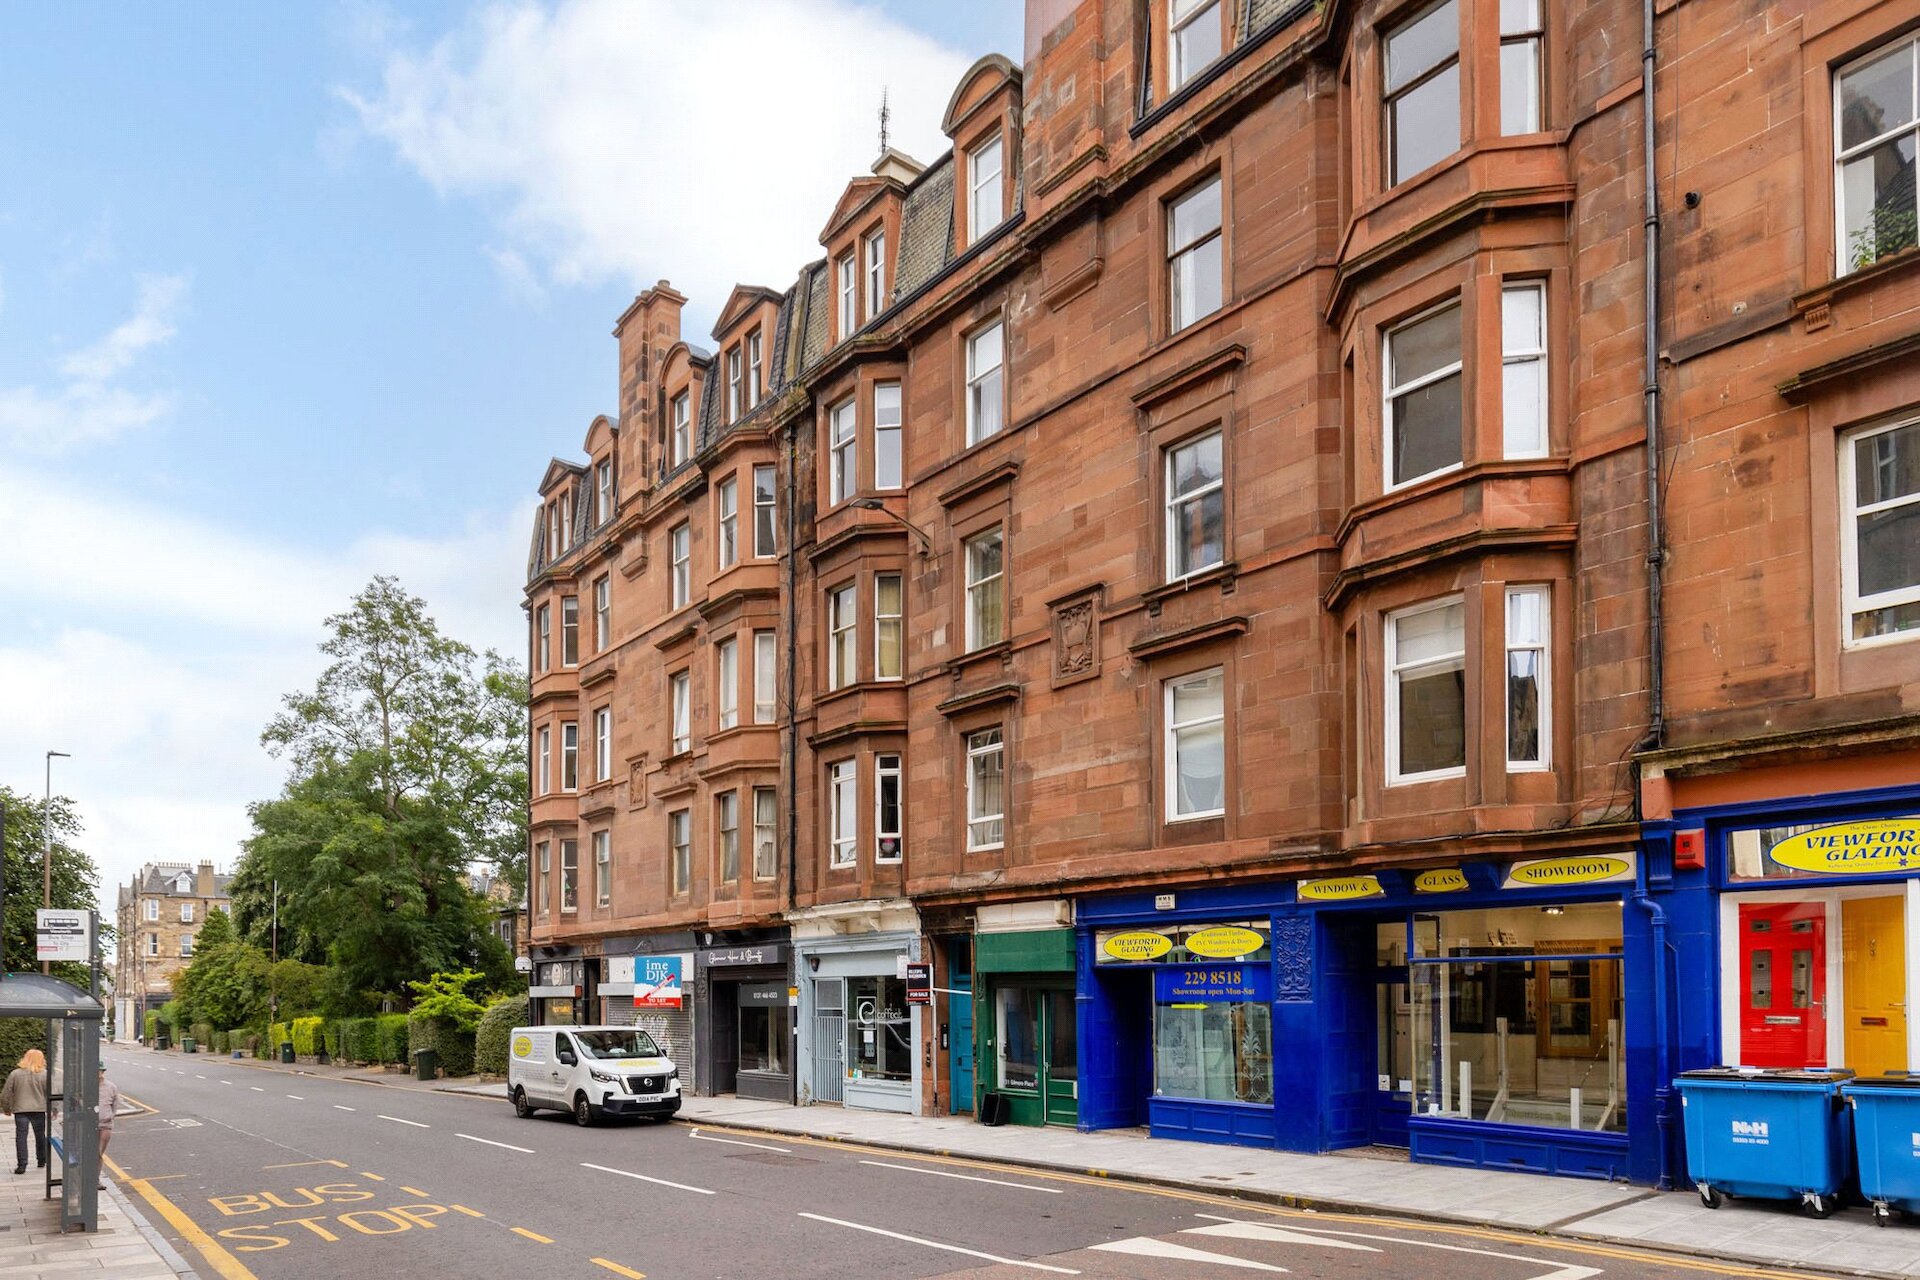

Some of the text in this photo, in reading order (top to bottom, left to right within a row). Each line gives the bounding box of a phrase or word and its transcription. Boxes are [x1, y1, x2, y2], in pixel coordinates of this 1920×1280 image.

[1806, 829, 1920, 848] VIEWFOR
[1526, 863, 1610, 878] SHOWROOM
[1424, 875, 1461, 885] GLASS
[1314, 882, 1368, 894] WINDOW &
[646, 970, 669, 982] DJK
[1185, 971, 1242, 984] 229 8518
[208, 1184, 375, 1216] BUS
[217, 1204, 448, 1251] STOP
